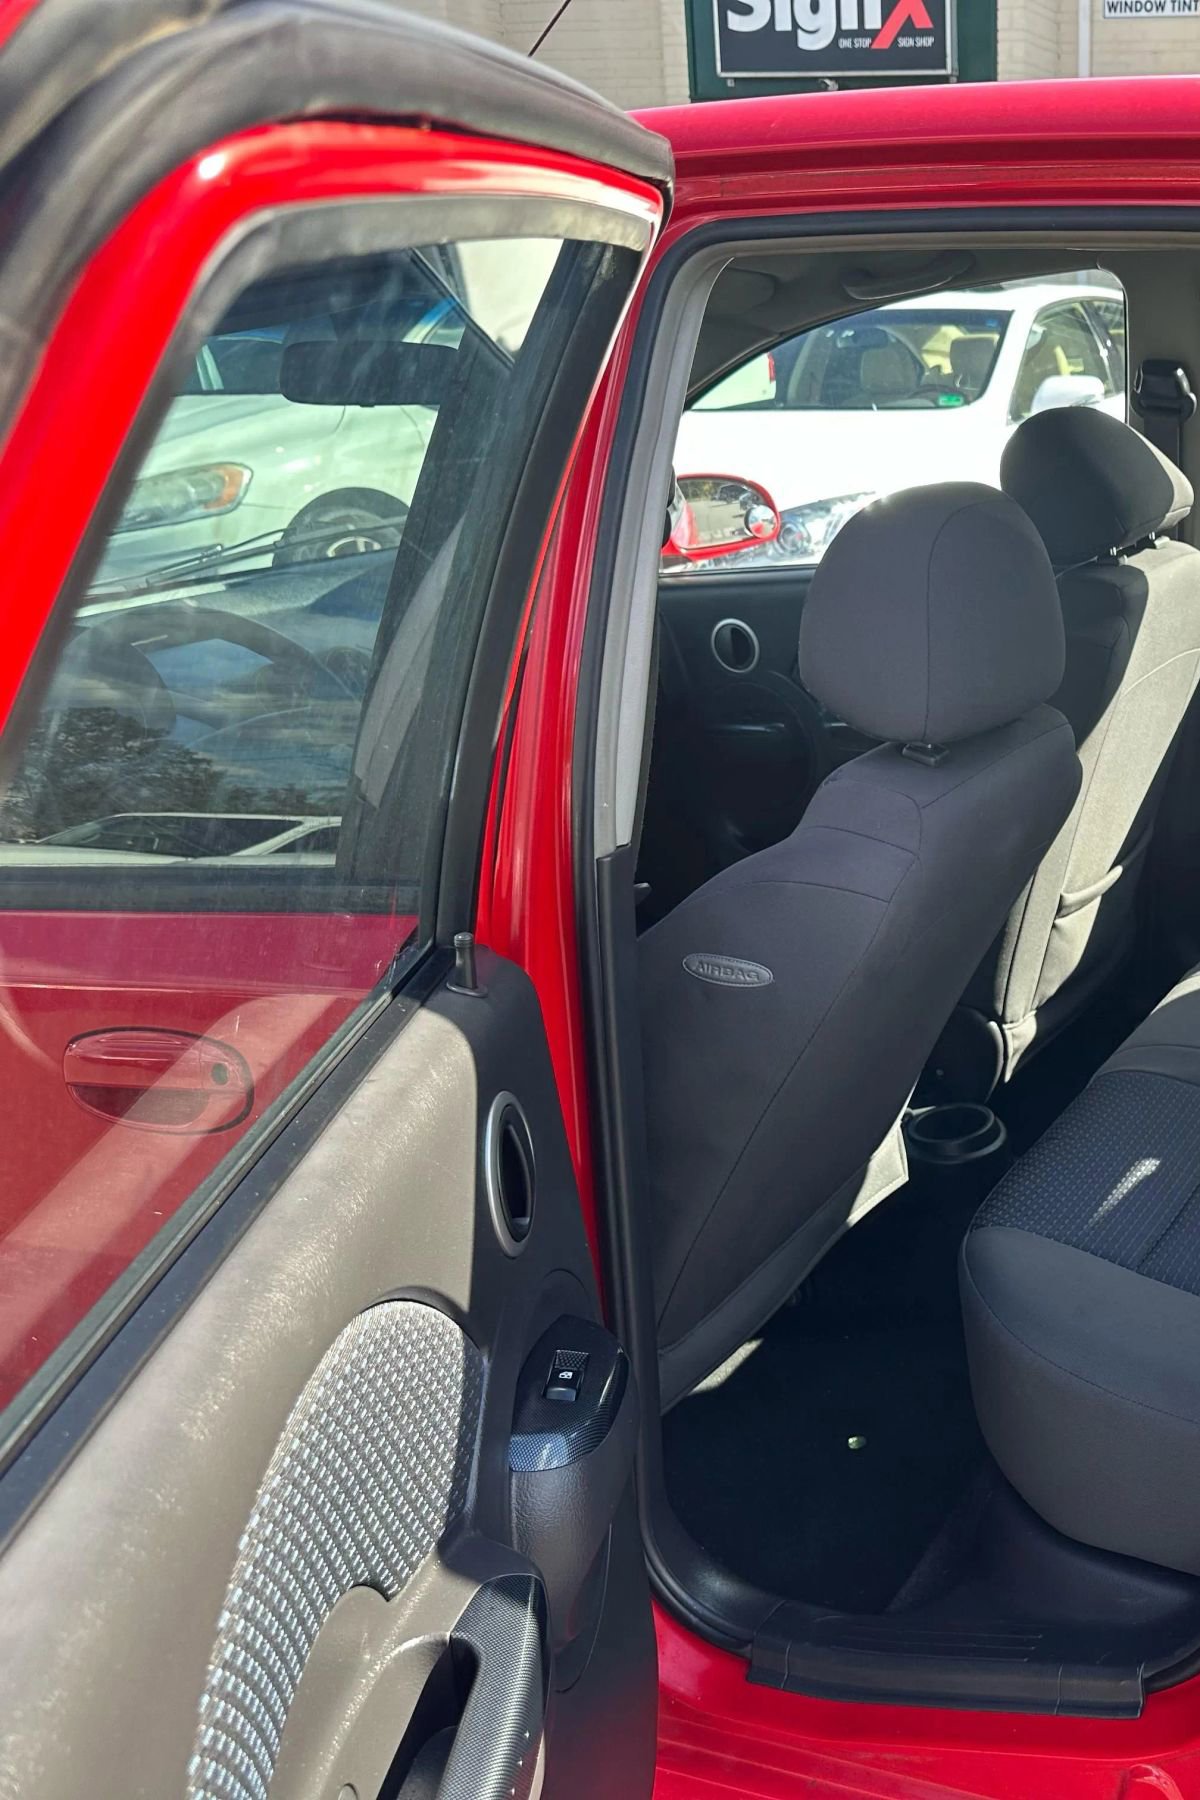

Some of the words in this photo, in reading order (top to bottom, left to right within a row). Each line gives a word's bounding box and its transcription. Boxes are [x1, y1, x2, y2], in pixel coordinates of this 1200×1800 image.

[1106, 0, 1166, 13] WINDOW
[1171, 0, 1199, 12] TINT
[838, 38, 852, 49] ONE
[853, 37, 872, 48] STOP
[897, 37, 915, 48] SIGN
[916, 36, 935, 47] SHOP
[697, 960, 760, 982] AIRBAG
